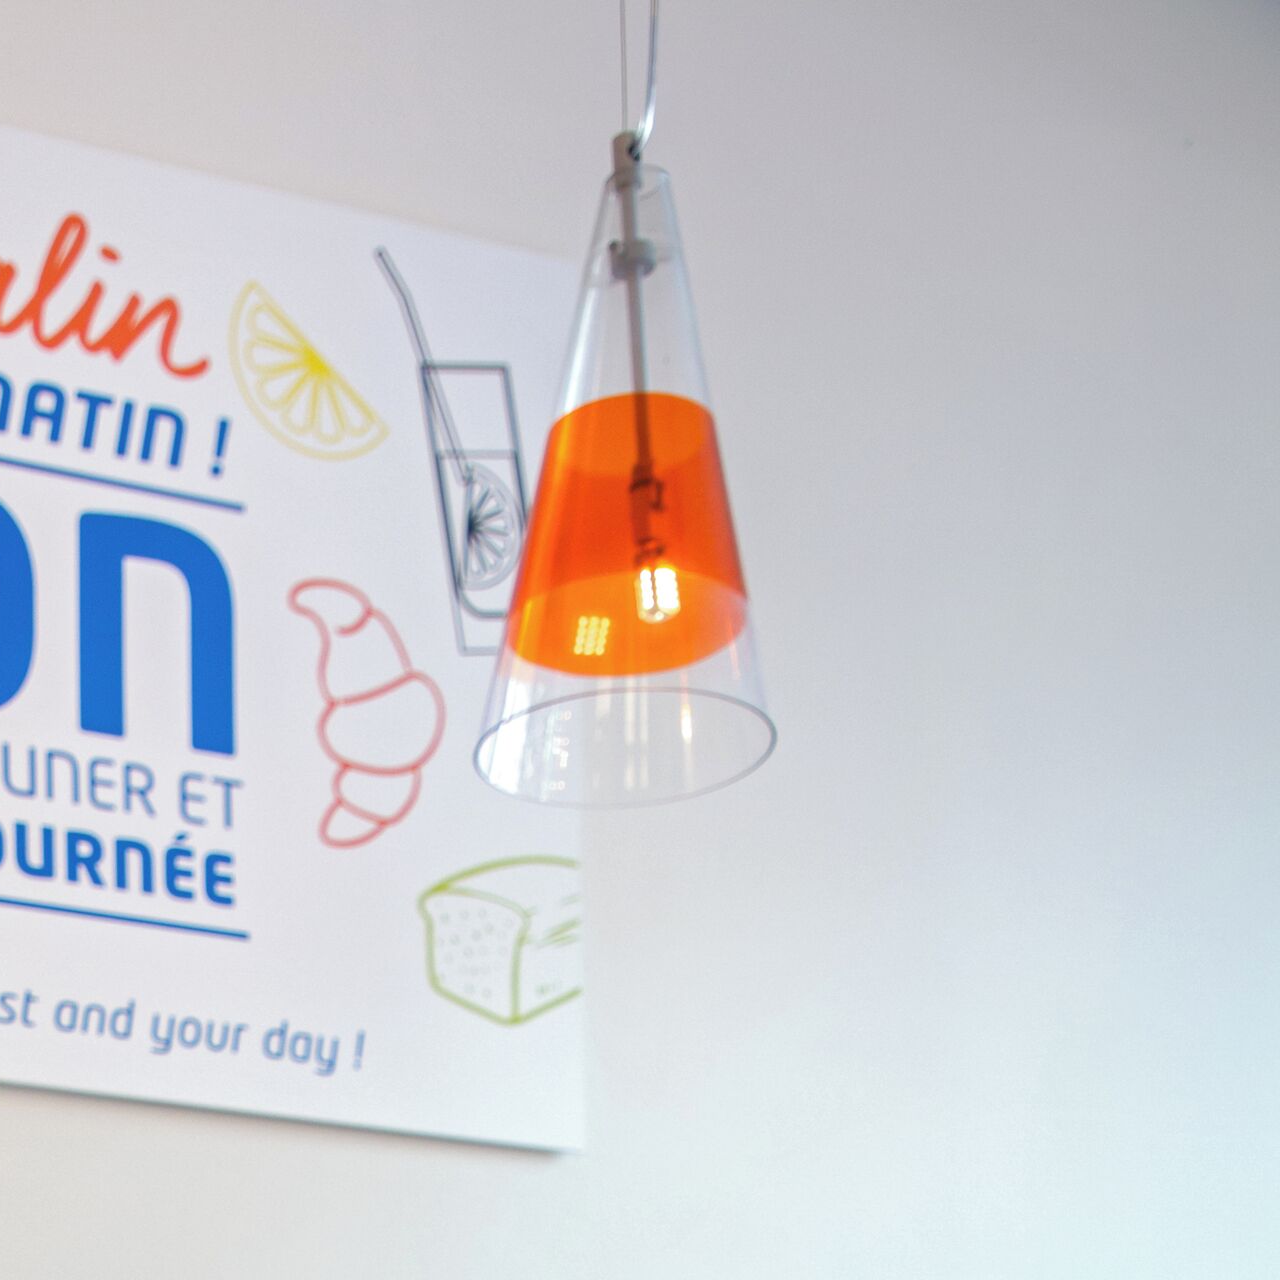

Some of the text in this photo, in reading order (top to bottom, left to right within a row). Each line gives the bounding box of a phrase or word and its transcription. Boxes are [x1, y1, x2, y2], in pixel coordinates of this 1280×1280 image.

[210, 417, 230, 477] !
[177, 771, 243, 829] ET
[53, 999, 136, 1040] and
[149, 1013, 248, 1055] your
[261, 1020, 341, 1076] day
[353, 1030, 366, 1070] !
